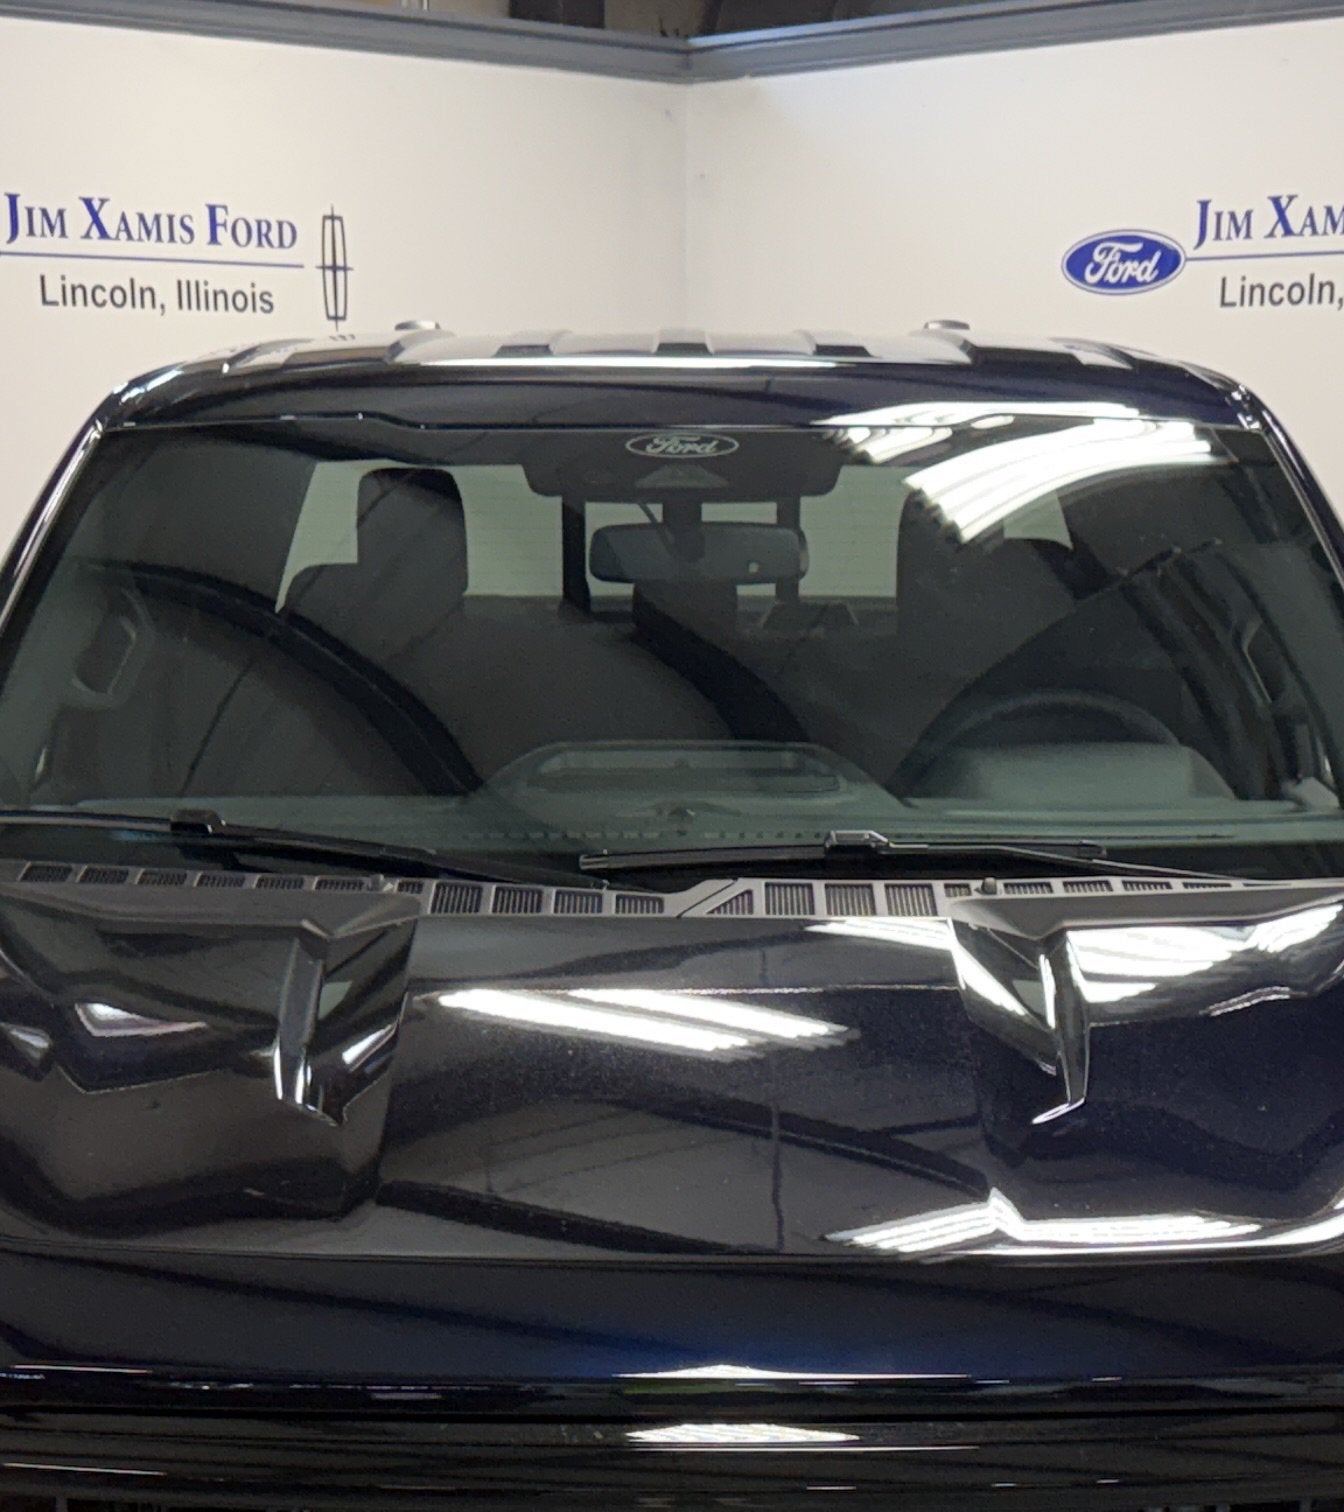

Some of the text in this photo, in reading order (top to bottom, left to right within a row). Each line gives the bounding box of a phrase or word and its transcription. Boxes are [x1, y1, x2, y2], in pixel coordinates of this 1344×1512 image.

[4, 192, 298, 249] JIM XAMIS FORD
[1193, 199, 1254, 250] JIM
[1084, 241, 1162, 285] Ford
[39, 274, 274, 316] Lincoln, Illinois
[1219, 272, 1344, 311] Lincoln,
[646, 435, 719, 454] Ford
